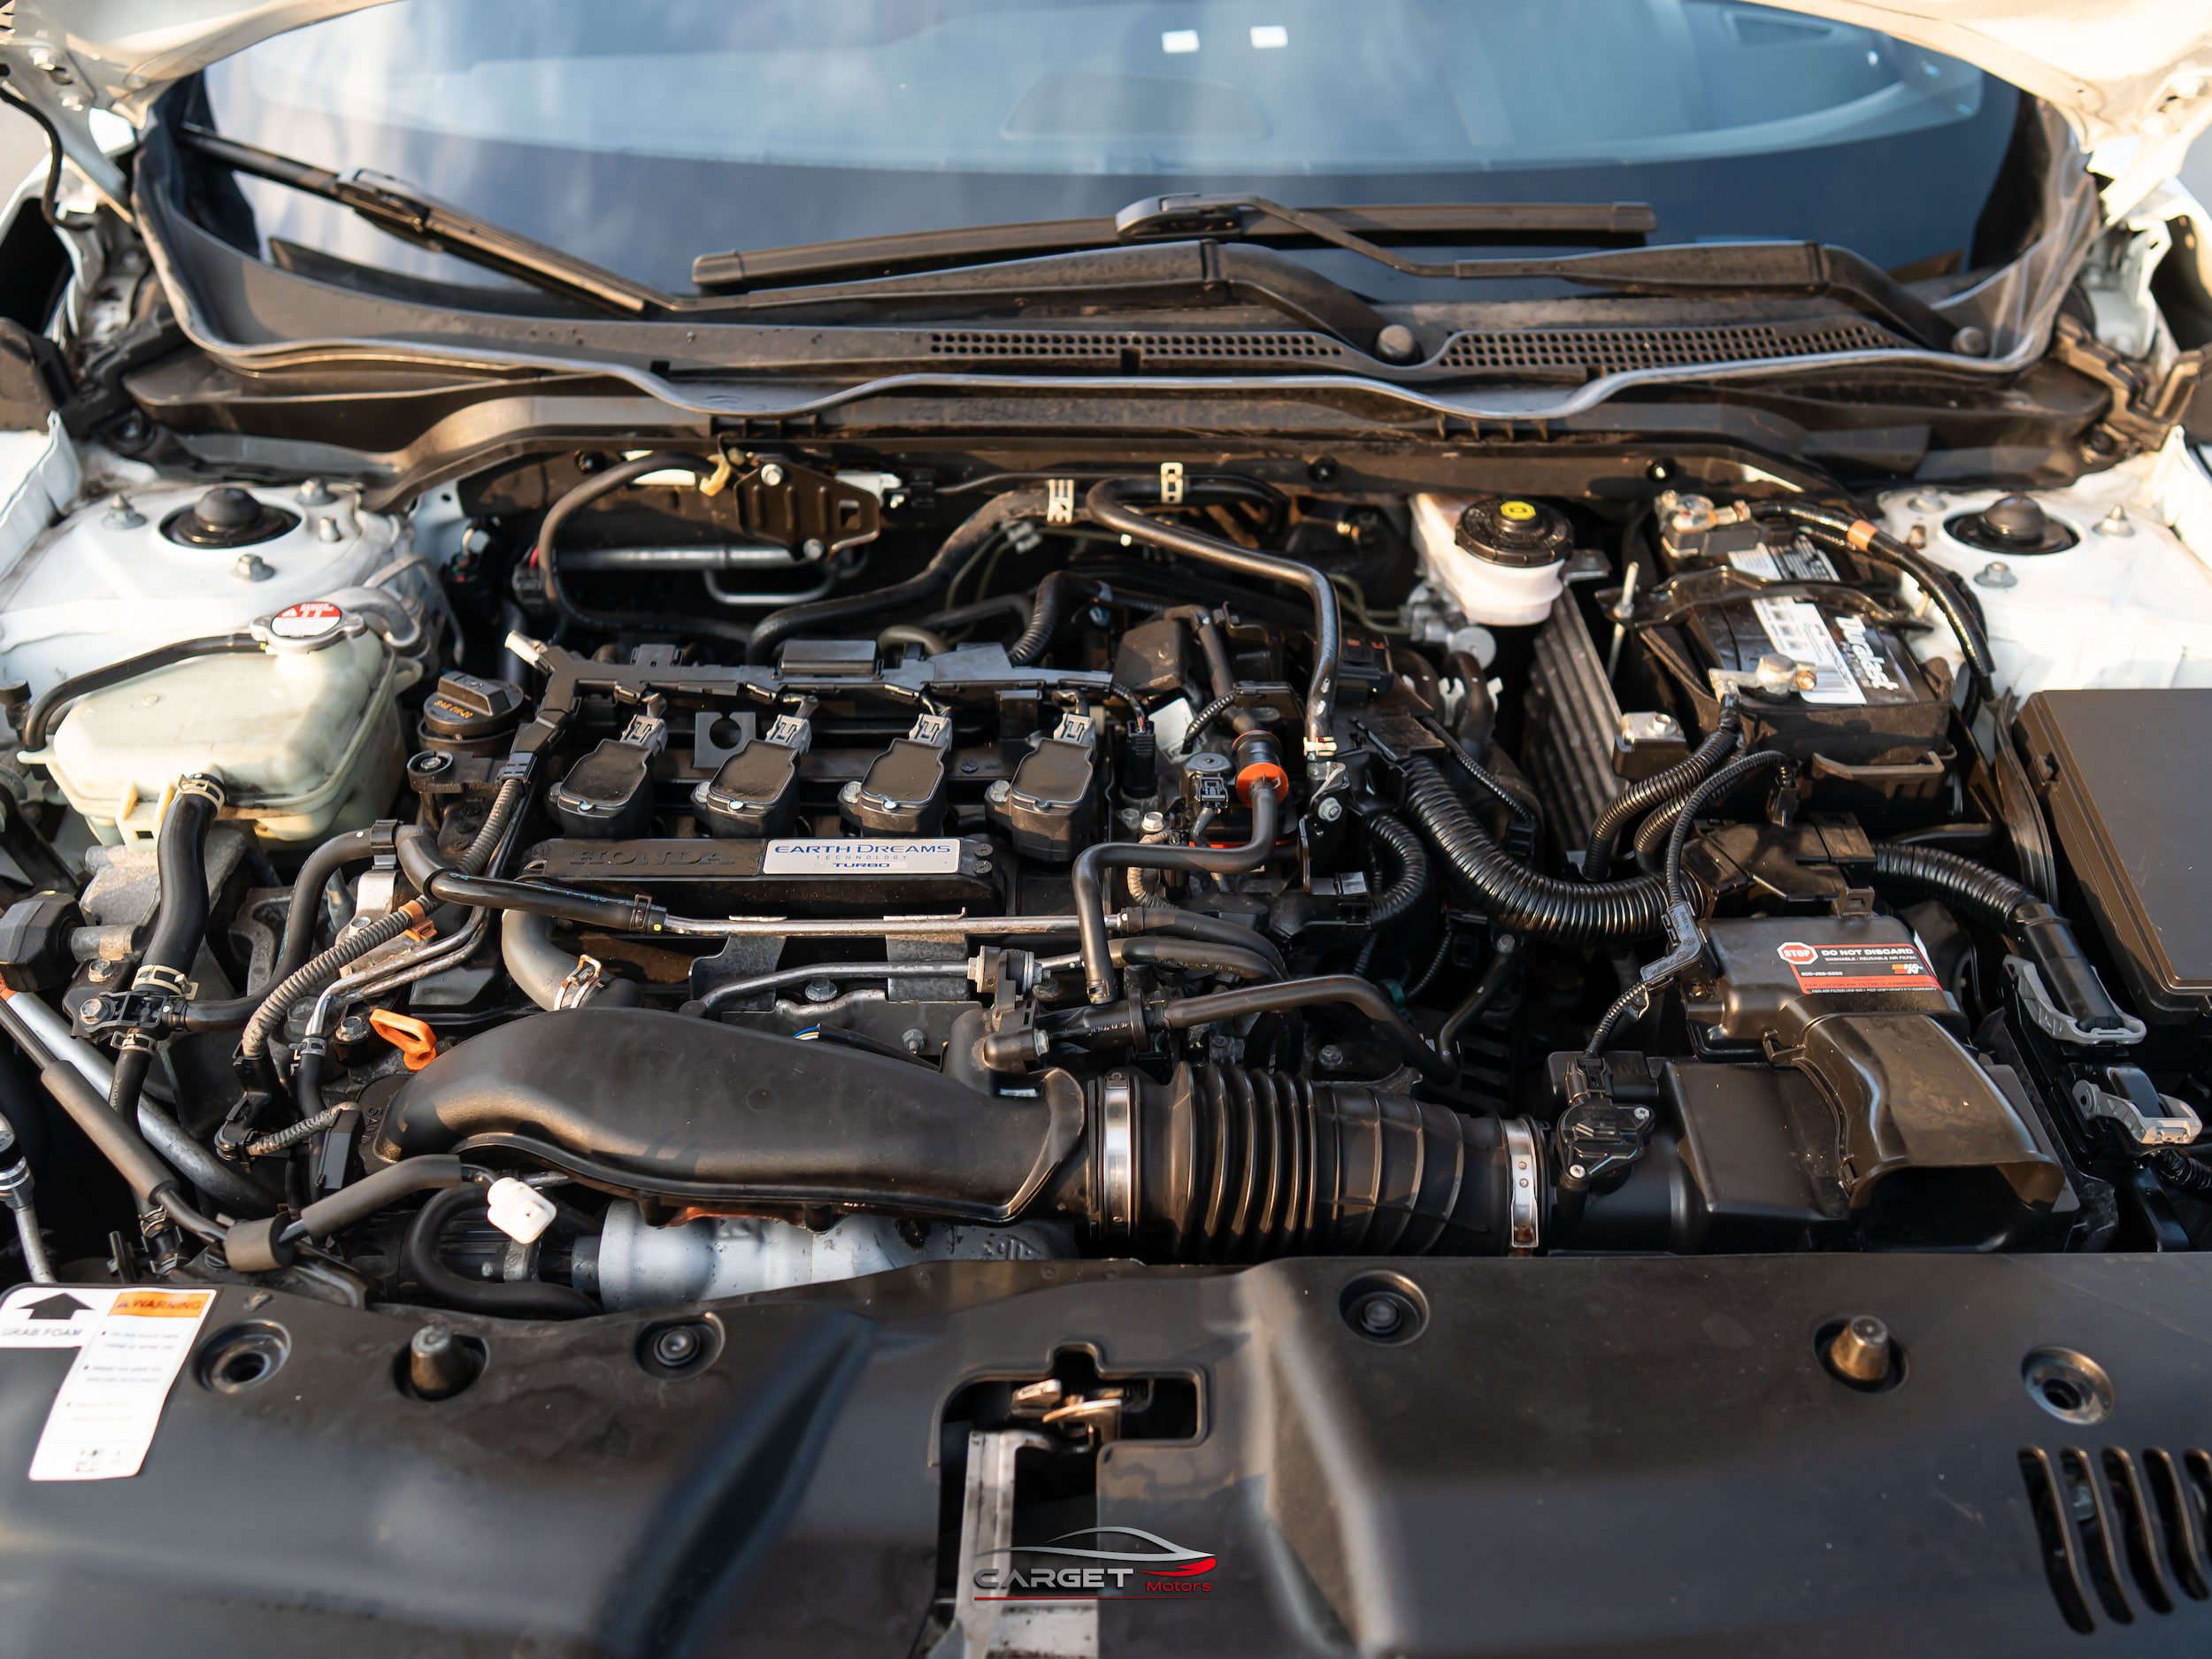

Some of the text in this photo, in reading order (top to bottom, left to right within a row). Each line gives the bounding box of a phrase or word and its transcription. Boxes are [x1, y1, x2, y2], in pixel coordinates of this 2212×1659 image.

[1835, 615, 1900, 690] Duralast
[774, 844, 951, 854] EARTH DREAMS
[569, 850, 735, 865] HONDA
[1783, 949, 1810, 958] STOP
[132, 1299, 202, 1310] WARNING
